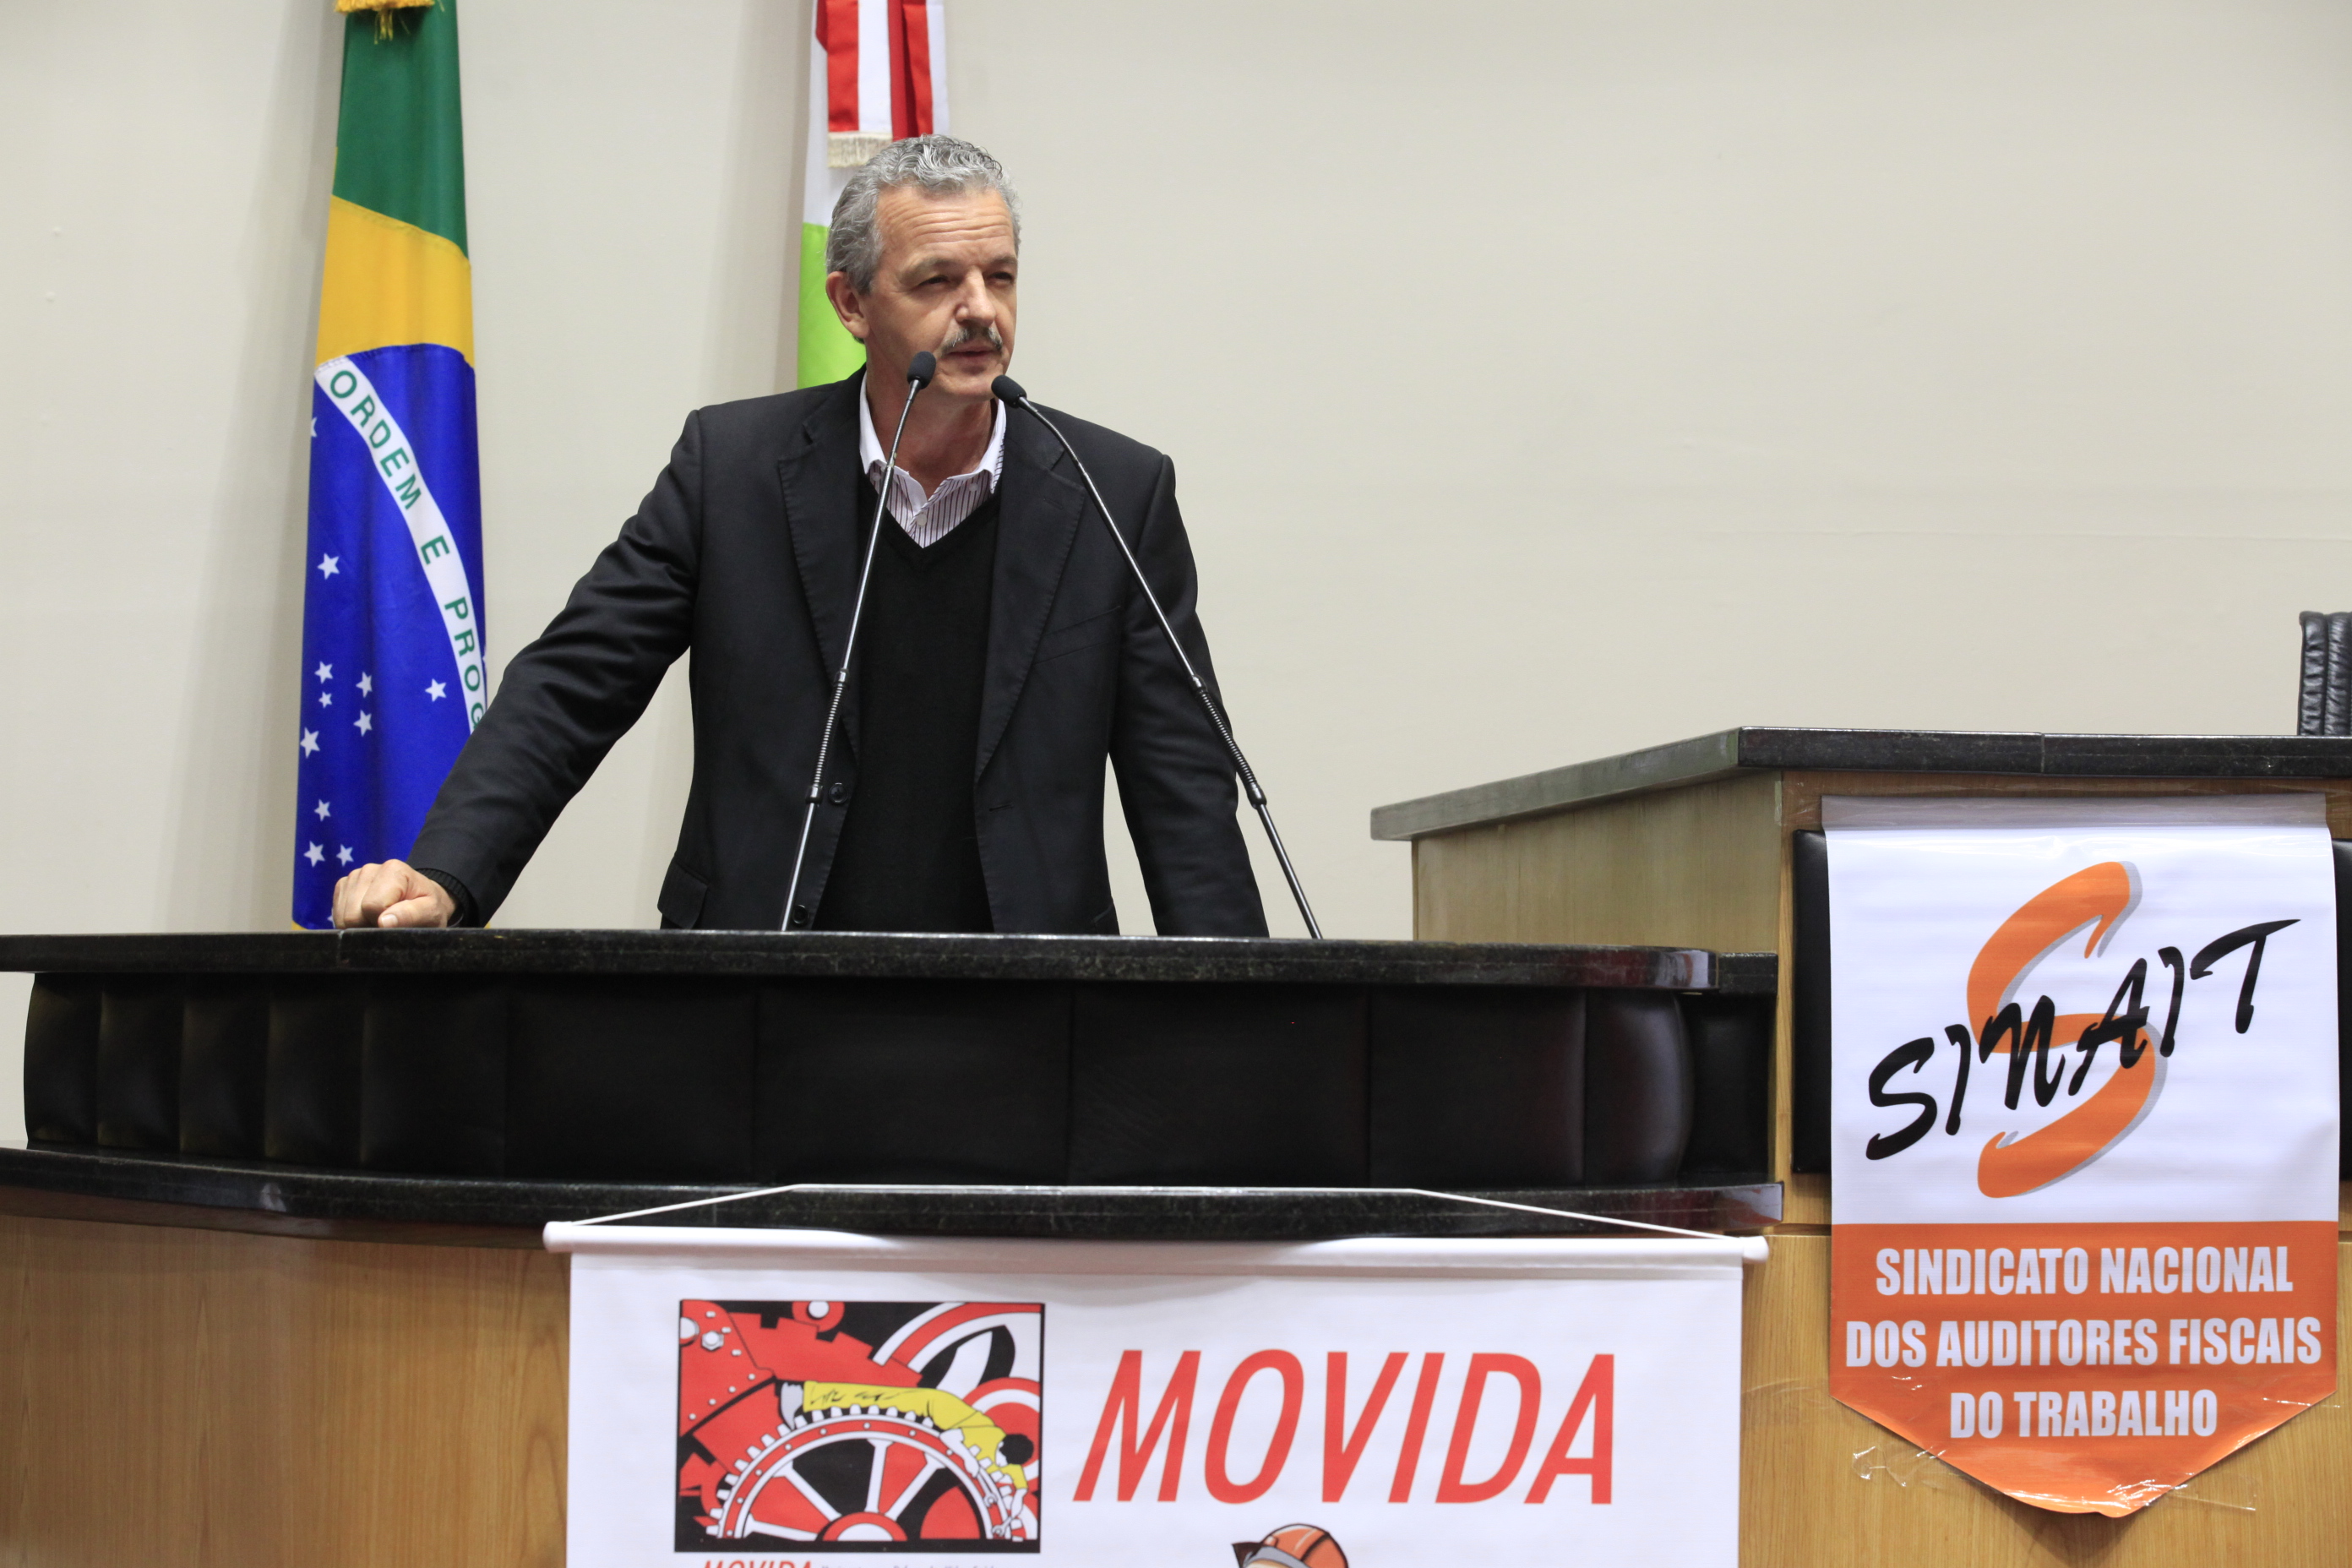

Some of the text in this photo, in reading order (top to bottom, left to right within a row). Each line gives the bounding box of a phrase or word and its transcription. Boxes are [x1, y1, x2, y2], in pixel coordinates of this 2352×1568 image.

[329, 370, 422, 510] ORDEM
[421, 535, 450, 564] E
[1865, 918, 2300, 1161] SINAIT
[1876, 1246, 2293, 1295] SINDICATO NACIONAL
[1847, 1317, 2322, 1367] DOS AUDITORES FISCAIS
[1074, 1349, 1614, 1504] MOVIDA
[1951, 1390, 2217, 1438] DO TRABALHO
